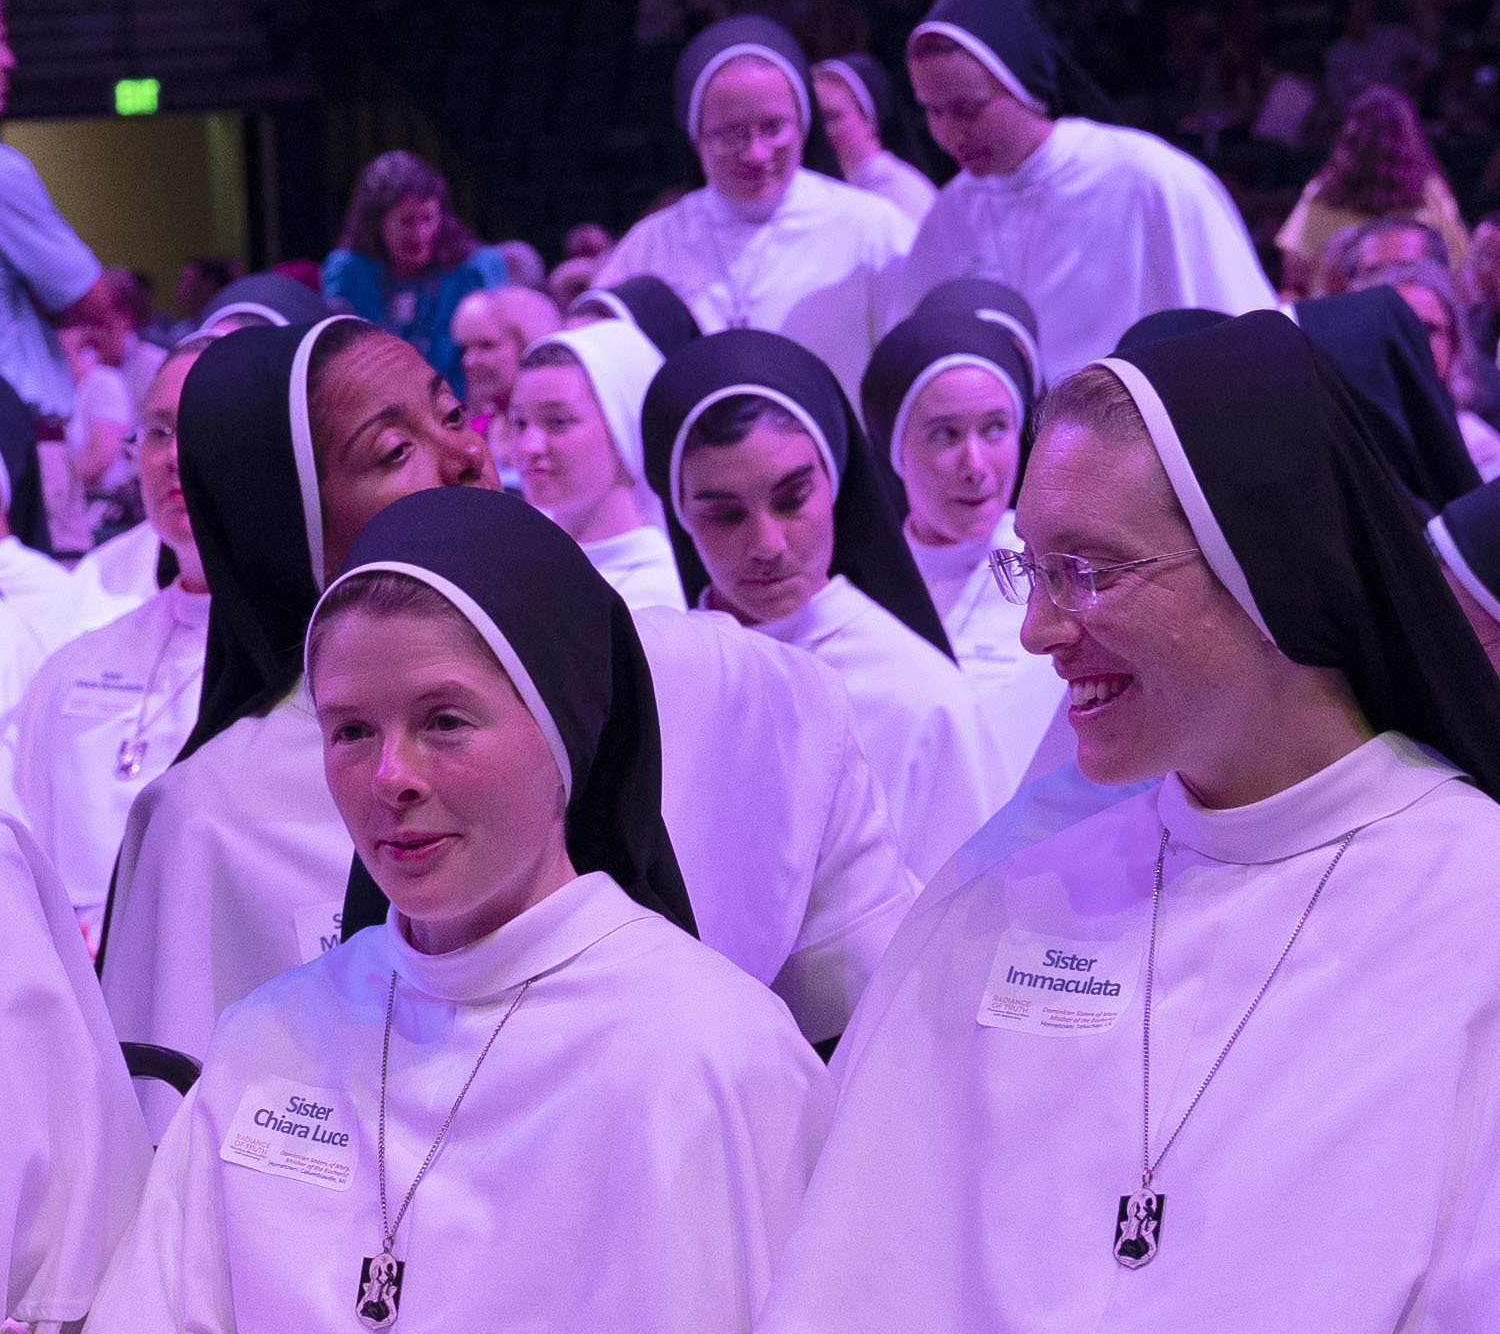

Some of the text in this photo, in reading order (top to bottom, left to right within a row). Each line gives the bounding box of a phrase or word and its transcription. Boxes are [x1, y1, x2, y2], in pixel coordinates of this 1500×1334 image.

[1042, 949, 1097, 972] Sister
[1006, 965, 1121, 997] Immaculata
[992, 995, 1031, 1006] RADIANCE
[286, 1095, 334, 1121] Sister
[254, 1109, 349, 1147] Chiara Luce
[236, 1133, 270, 1147] RADIANCE
[245, 1144, 267, 1154] TRUTH
